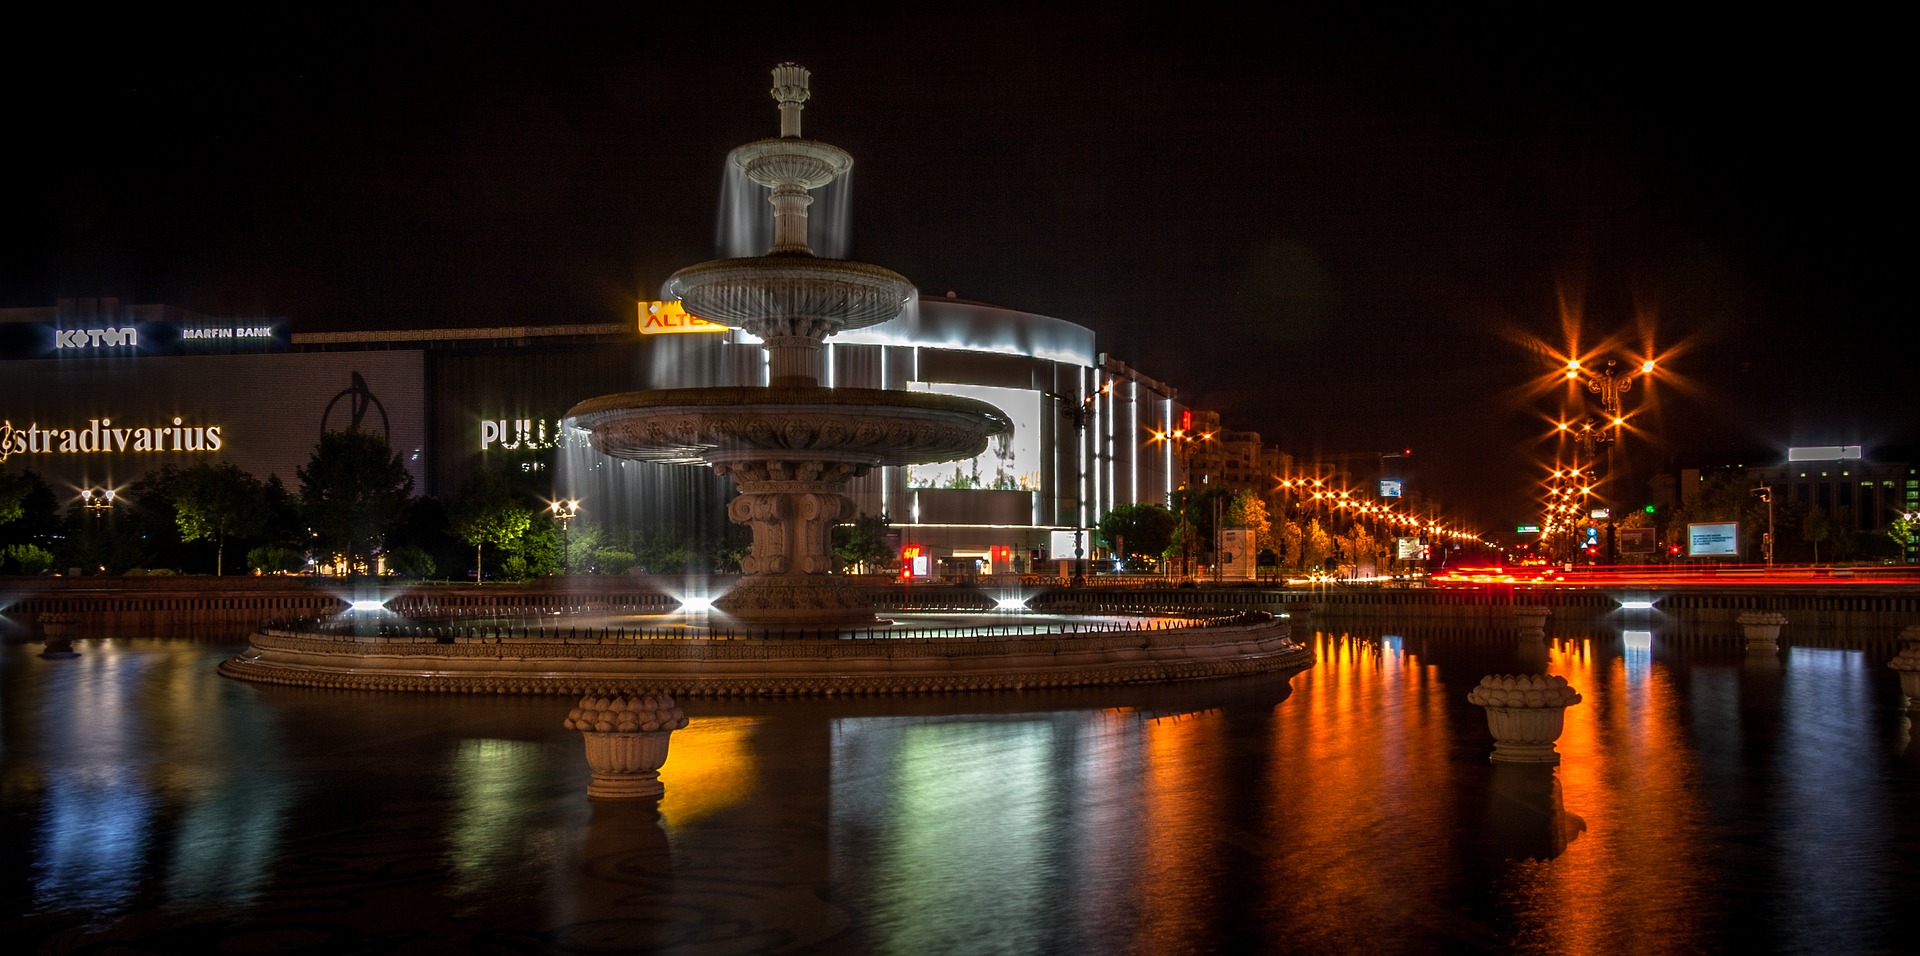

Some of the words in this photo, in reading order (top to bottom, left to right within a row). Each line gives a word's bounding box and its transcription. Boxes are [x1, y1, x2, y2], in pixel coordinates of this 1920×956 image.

[645, 313, 712, 328] ALTE
[183, 328, 233, 339] MARFIN
[236, 327, 272, 337] BANK
[14, 417, 223, 454] stradivarius
